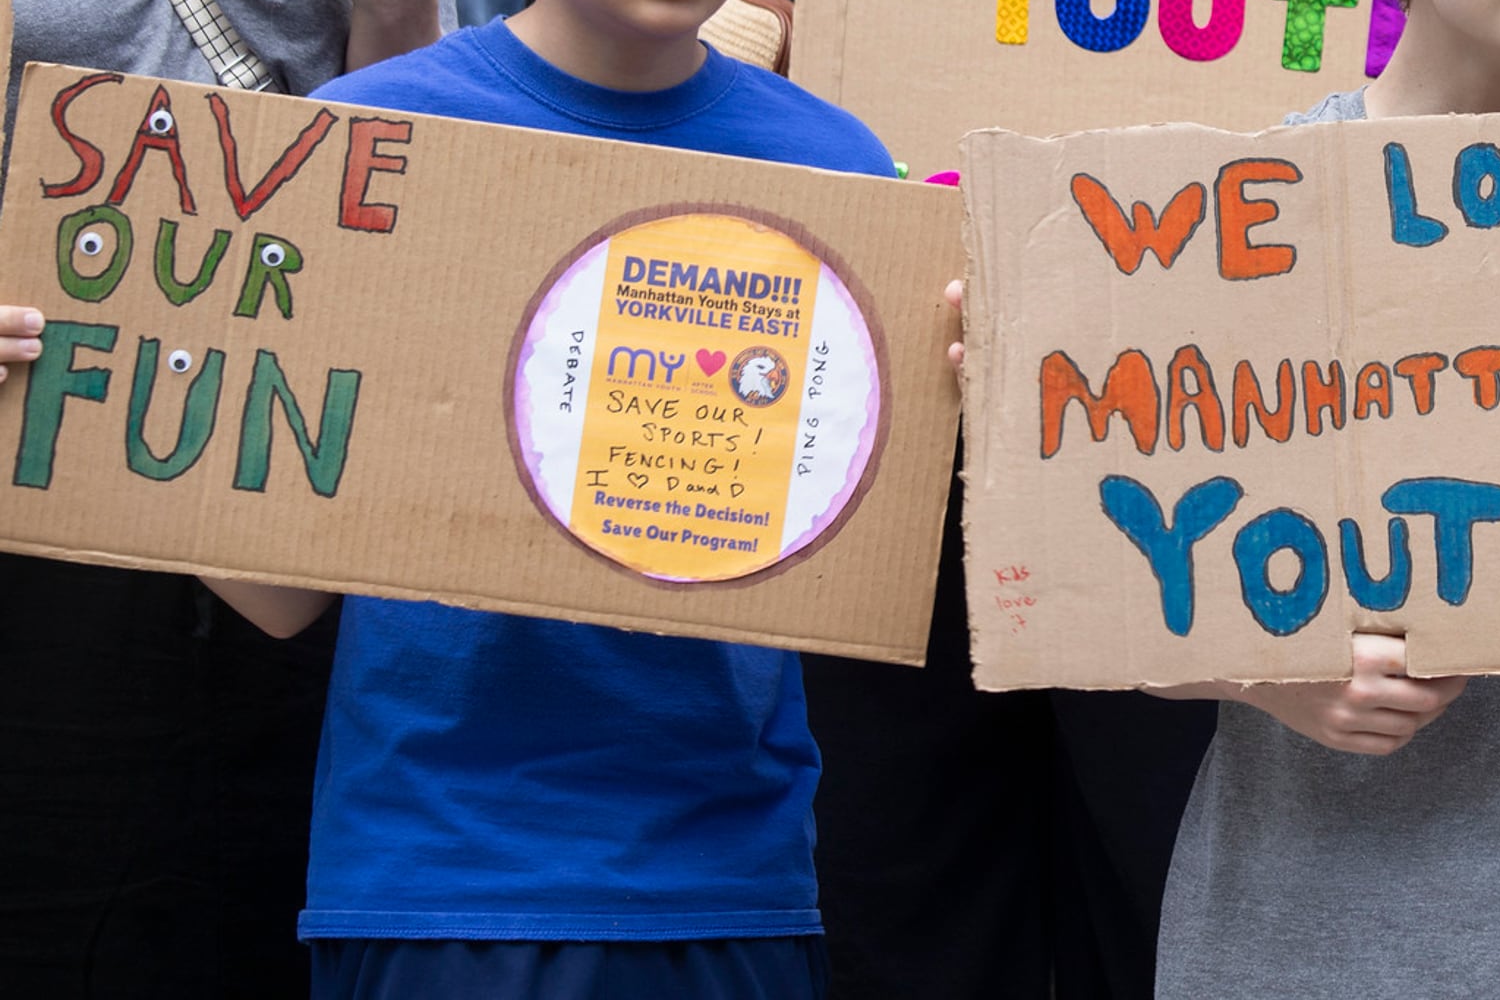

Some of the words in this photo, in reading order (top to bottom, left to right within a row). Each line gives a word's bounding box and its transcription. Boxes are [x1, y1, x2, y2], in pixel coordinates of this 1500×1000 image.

[40, 71, 414, 234] SAVE
[1069, 156, 1304, 283] WE
[57, 205, 305, 320] OUR
[622, 255, 803, 306] DEMAND!!!
[615, 298, 733, 330] YORKVILLE
[737, 314, 800, 339] EAST!
[617, 284, 694, 306] Manhattan
[698, 294, 738, 313] Youth
[742, 301, 782, 319] Stays
[785, 308, 801, 321] at
[559, 329, 585, 414] DEBATE
[807, 340, 831, 401] PONG
[13, 319, 363, 498] FUN
[606, 389, 681, 420] SAVE
[695, 403, 749, 427] OUR
[797, 416, 821, 477] PING
[586, 469, 610, 488] I
[667, 475, 680, 492] D
[686, 483, 721, 497] and
[731, 482, 745, 498] D
[594, 490, 661, 514] Reverse
[665, 499, 692, 518] the
[695, 503, 770, 527] Decision!
[602, 518, 642, 539] Save
[646, 524, 678, 543] Our
[681, 528, 759, 553] Program!
